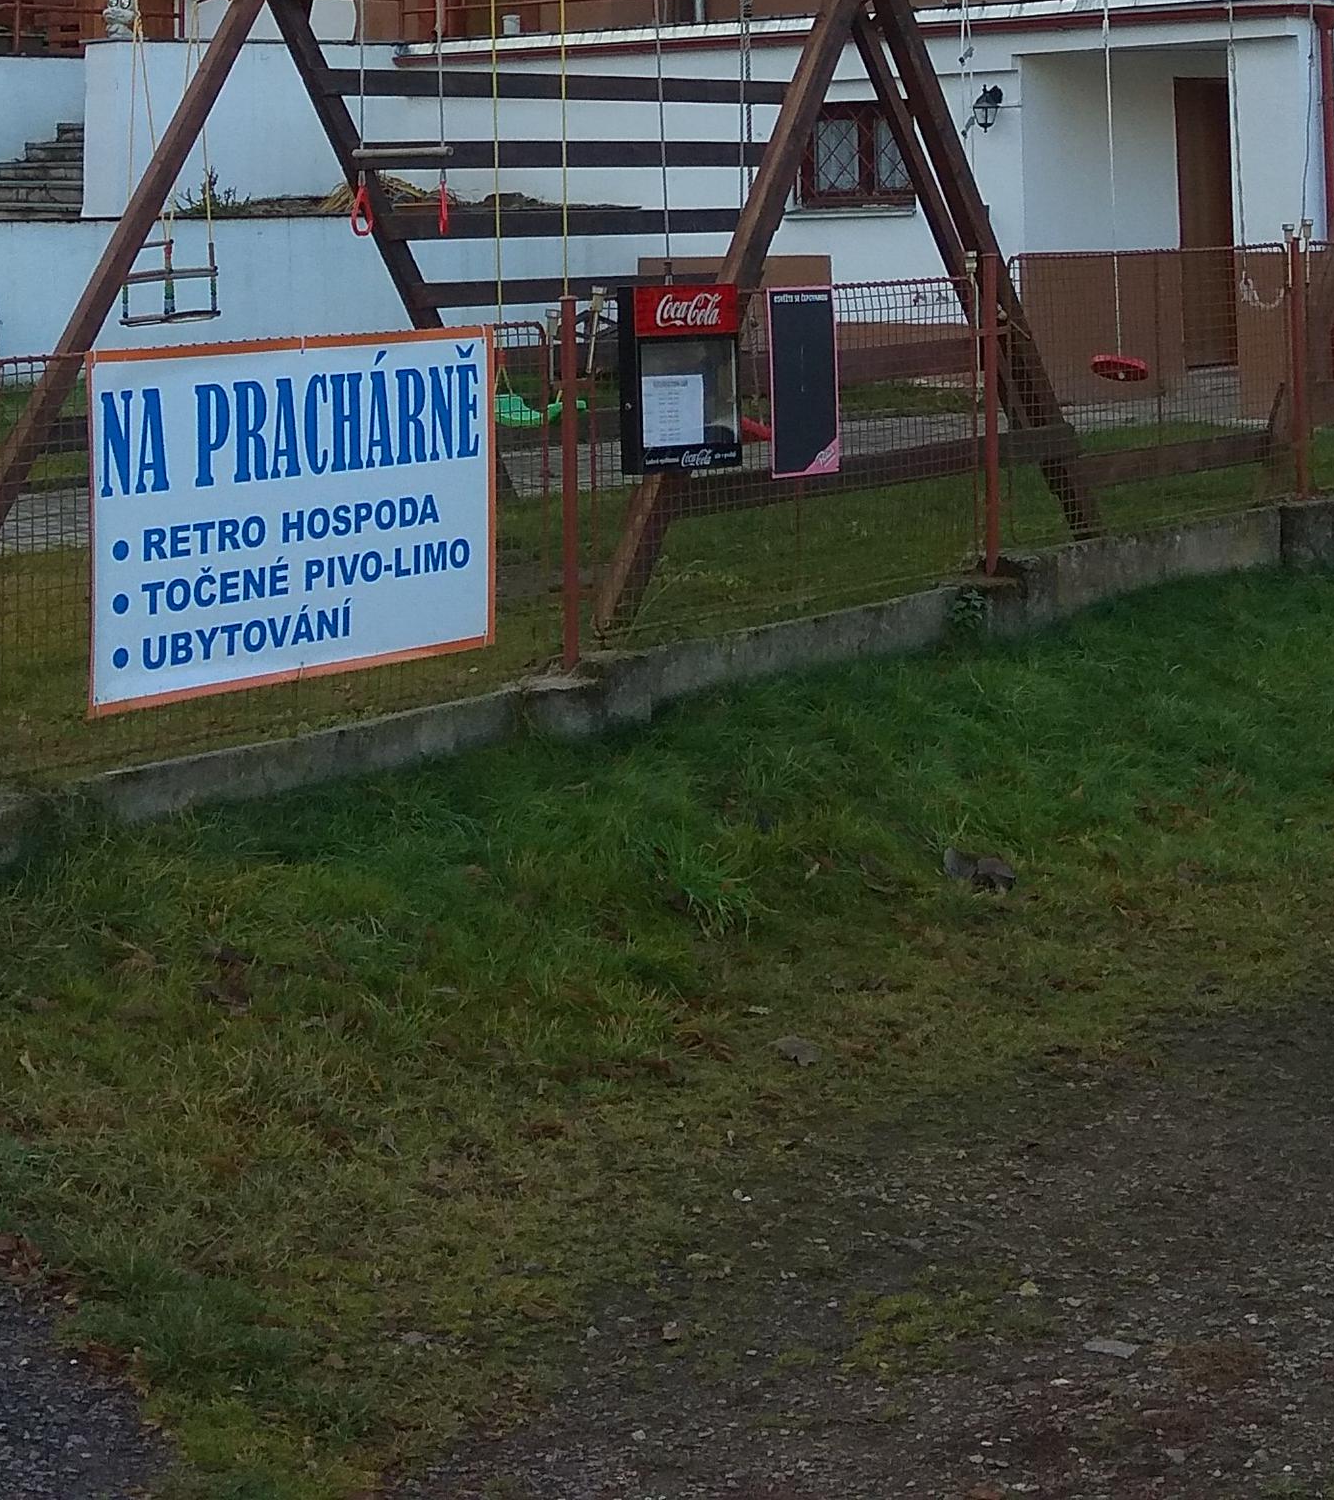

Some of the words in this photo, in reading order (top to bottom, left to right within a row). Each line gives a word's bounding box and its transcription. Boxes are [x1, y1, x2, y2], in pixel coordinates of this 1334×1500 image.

[99, 387, 170, 498] NA
[194, 342, 480, 489] PRACHÁRNĚ
[142, 514, 266, 562] RETRO
[281, 493, 440, 544] HOSPODA
[141, 556, 290, 616] TOČENÉ
[304, 537, 471, 593] PIVO-LIMO
[142, 597, 352, 670] UBYTOVÁNÍ
